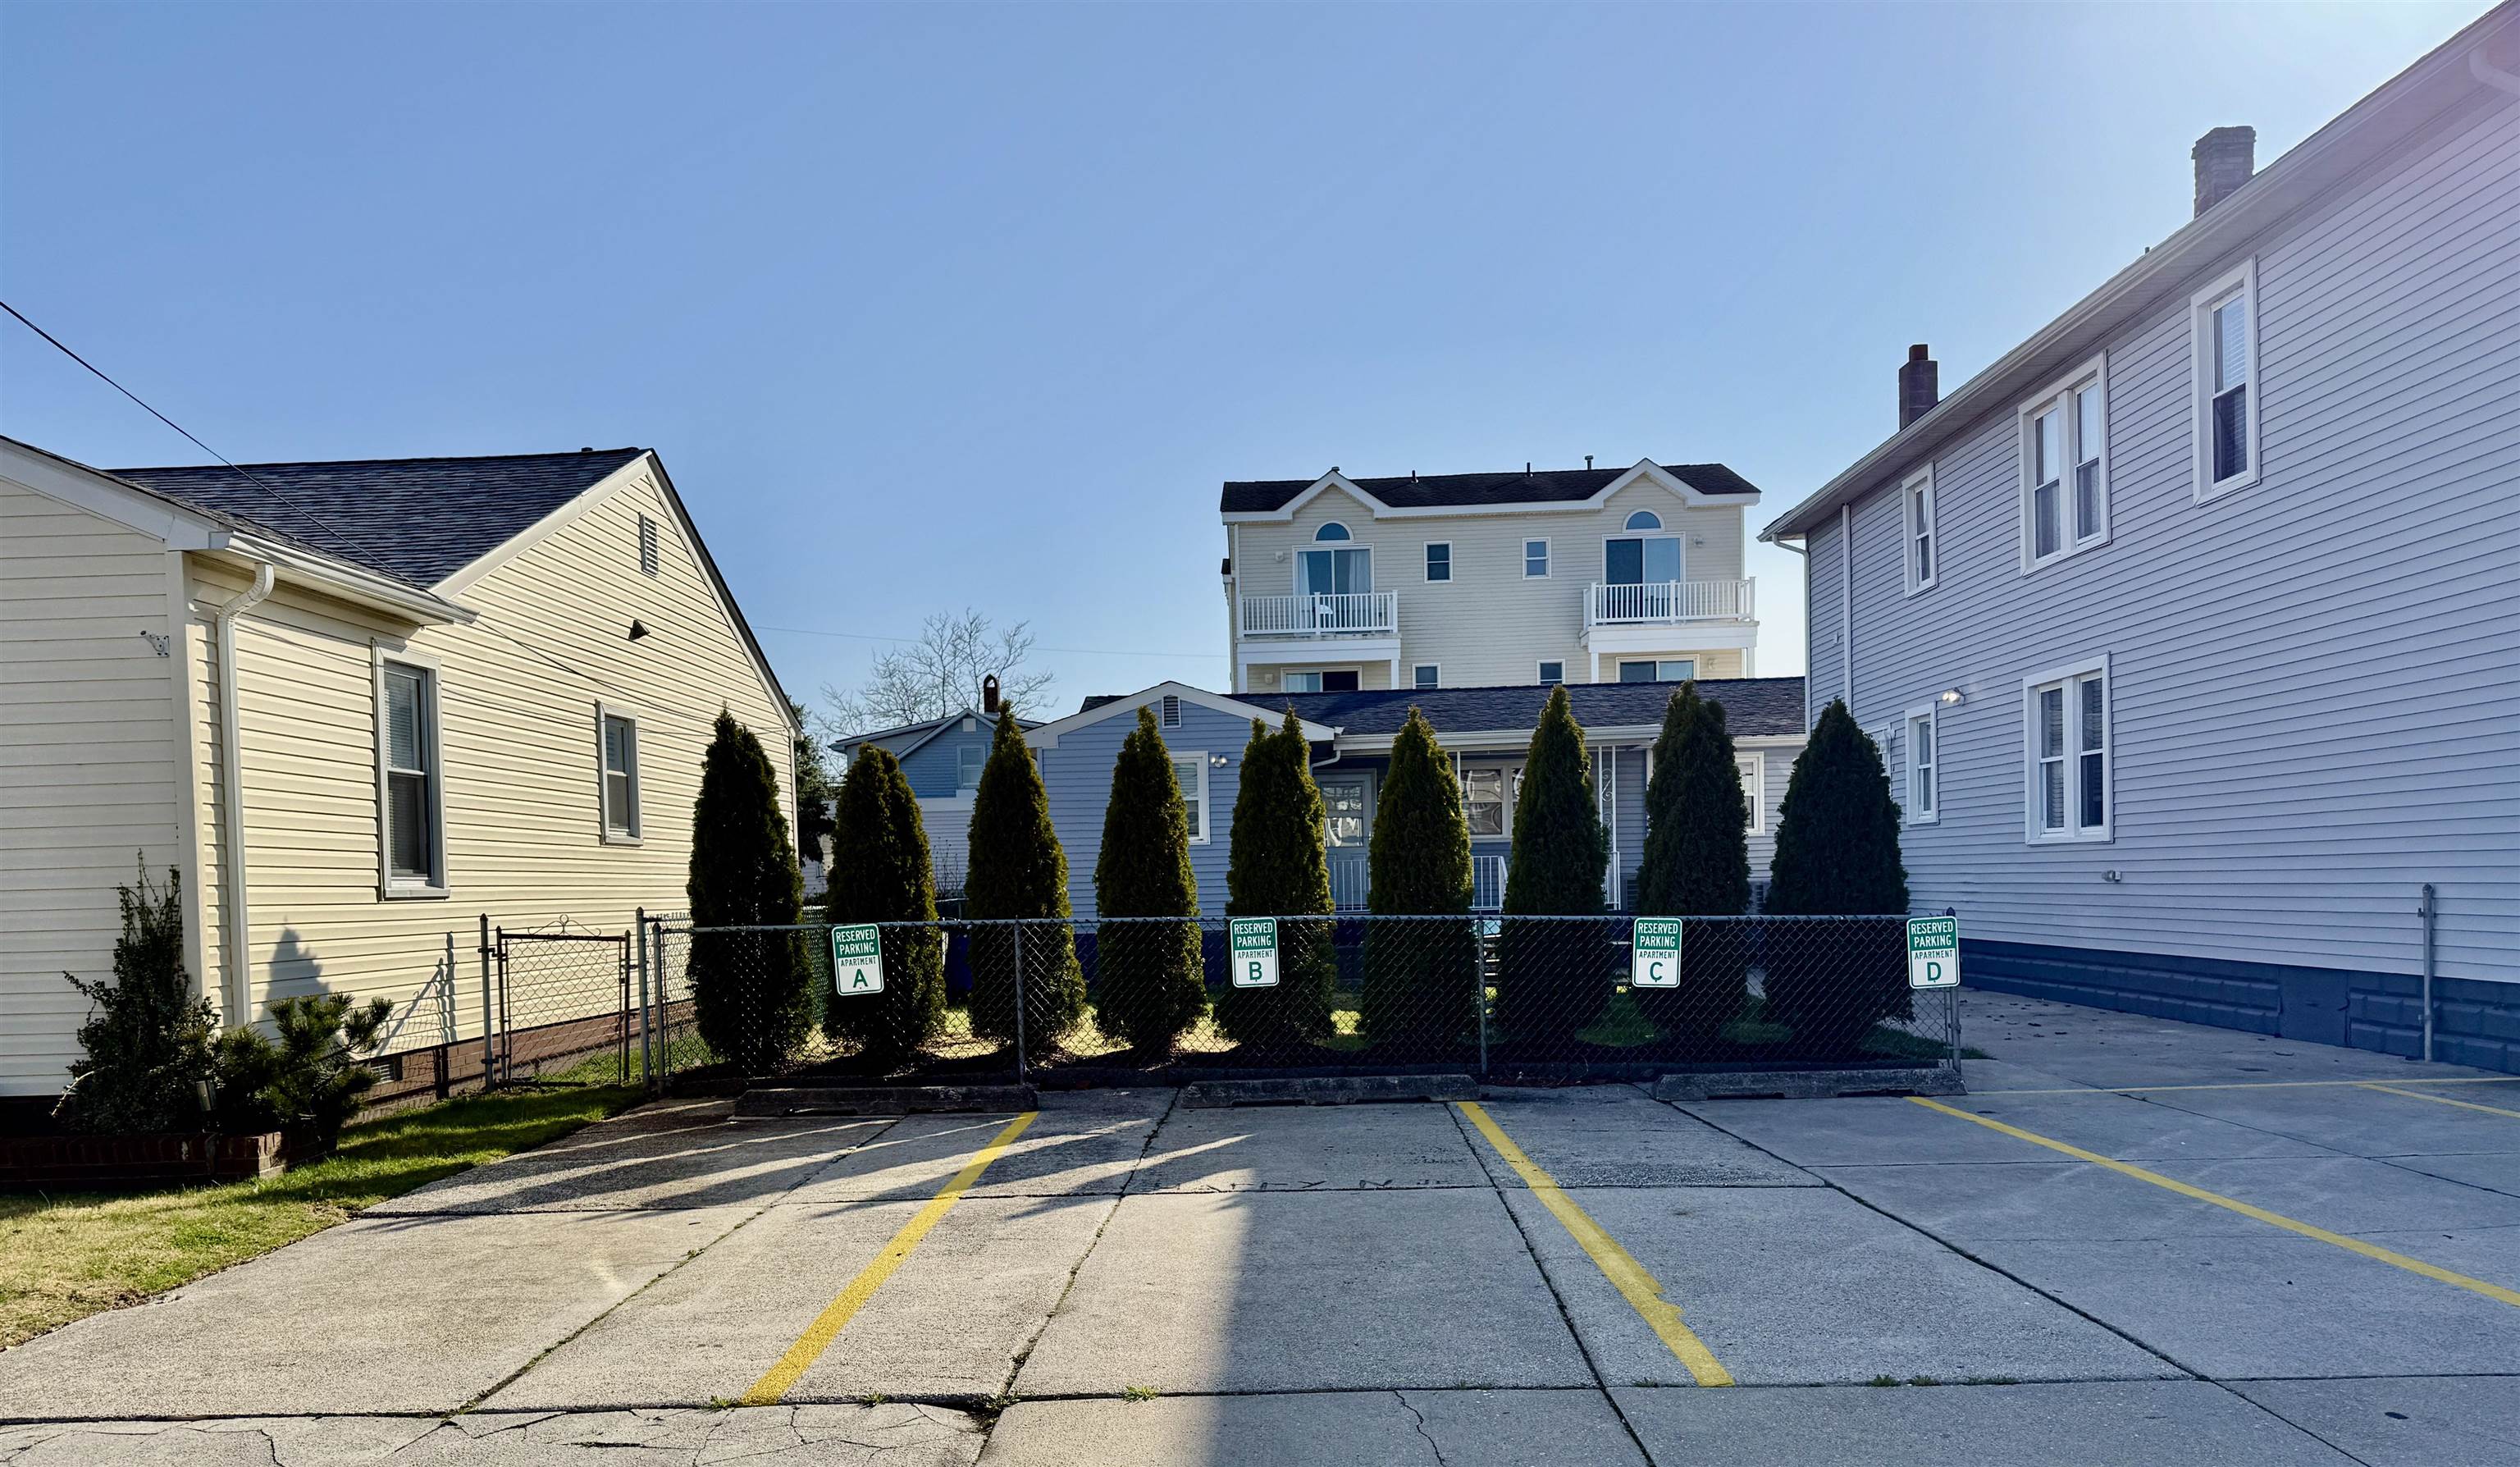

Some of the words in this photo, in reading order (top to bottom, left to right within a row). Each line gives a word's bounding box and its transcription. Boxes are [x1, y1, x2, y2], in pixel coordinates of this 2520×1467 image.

[1234, 922, 1273, 935] RESERVED
[1637, 922, 1678, 934] RESERVED
[1911, 921, 1953, 935] RESERVED
[836, 929, 875, 943] RESERVED
[1237, 935, 1271, 947] PARKING
[1640, 935, 1676, 947] PARKING
[1914, 934, 1952, 948] PARKING
[839, 942, 874, 956] PARKING
[1237, 949, 1273, 958] APARTMENT
[1914, 949, 1953, 960] APARTMENT
[841, 957, 876, 967] APARTMENT
[1249, 961, 1262, 980] B
[1650, 961, 1664, 980] C
[1926, 962, 1942, 981] D
[852, 968, 869, 988] A
